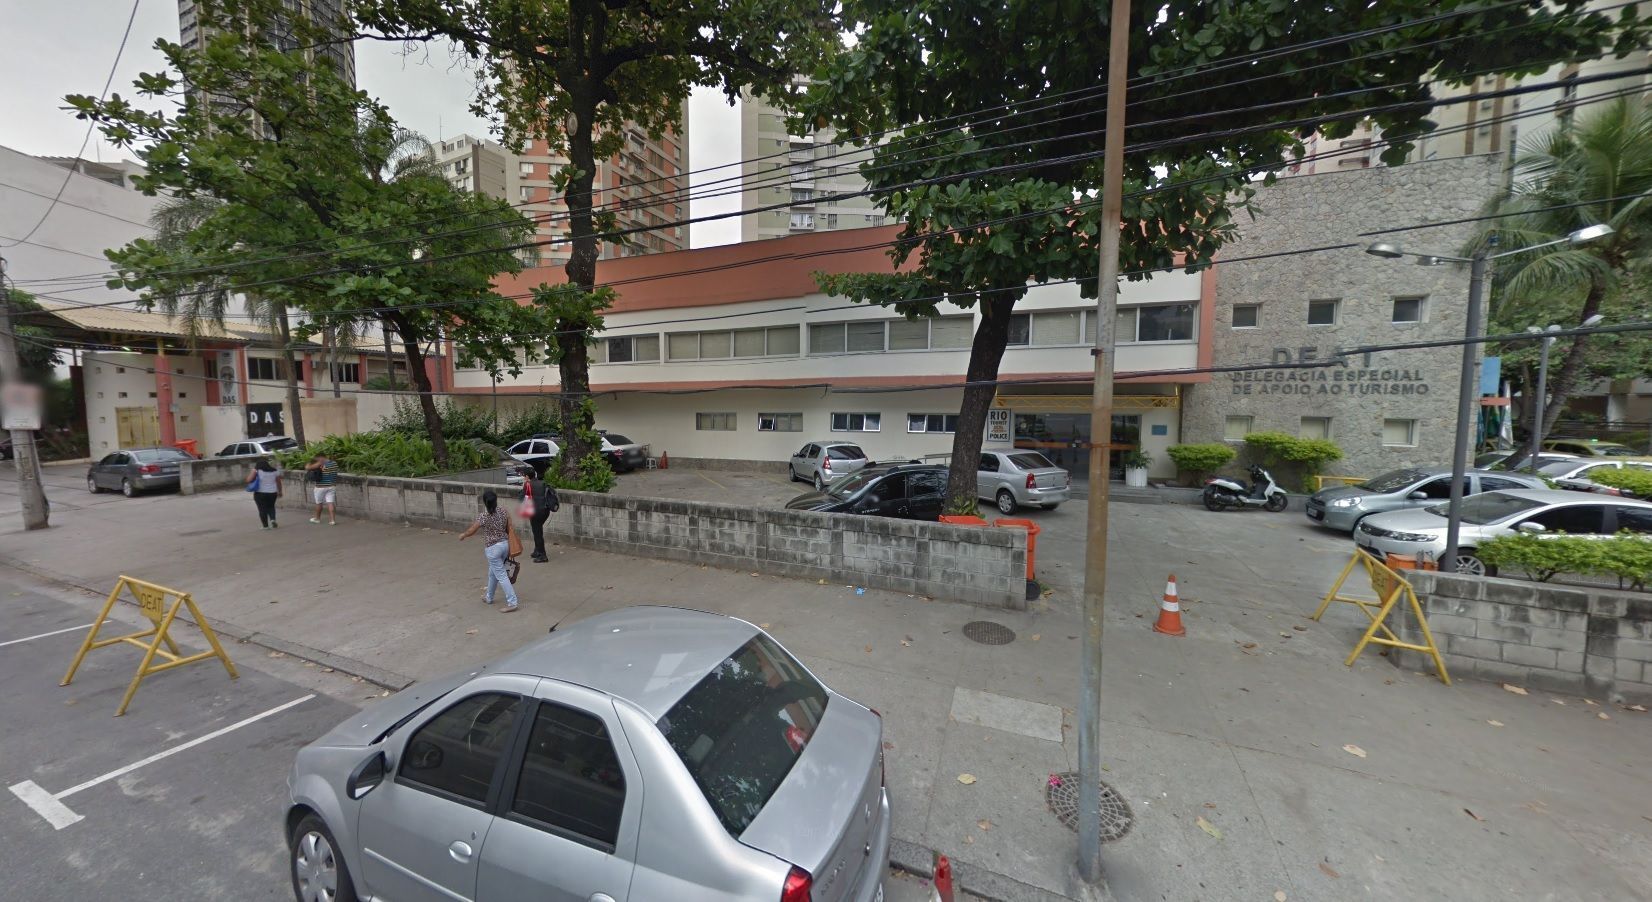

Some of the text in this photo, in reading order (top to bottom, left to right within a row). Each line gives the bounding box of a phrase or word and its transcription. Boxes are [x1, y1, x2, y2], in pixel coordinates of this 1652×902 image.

[1233, 370, 1424, 382] DELEGACIA ESPECIAL
[1233, 383, 1429, 395] DE APOIO AO TURISMO
[222, 395, 236, 404] DAS
[990, 411, 1008, 420] RIO
[141, 592, 162, 613] DEAT
